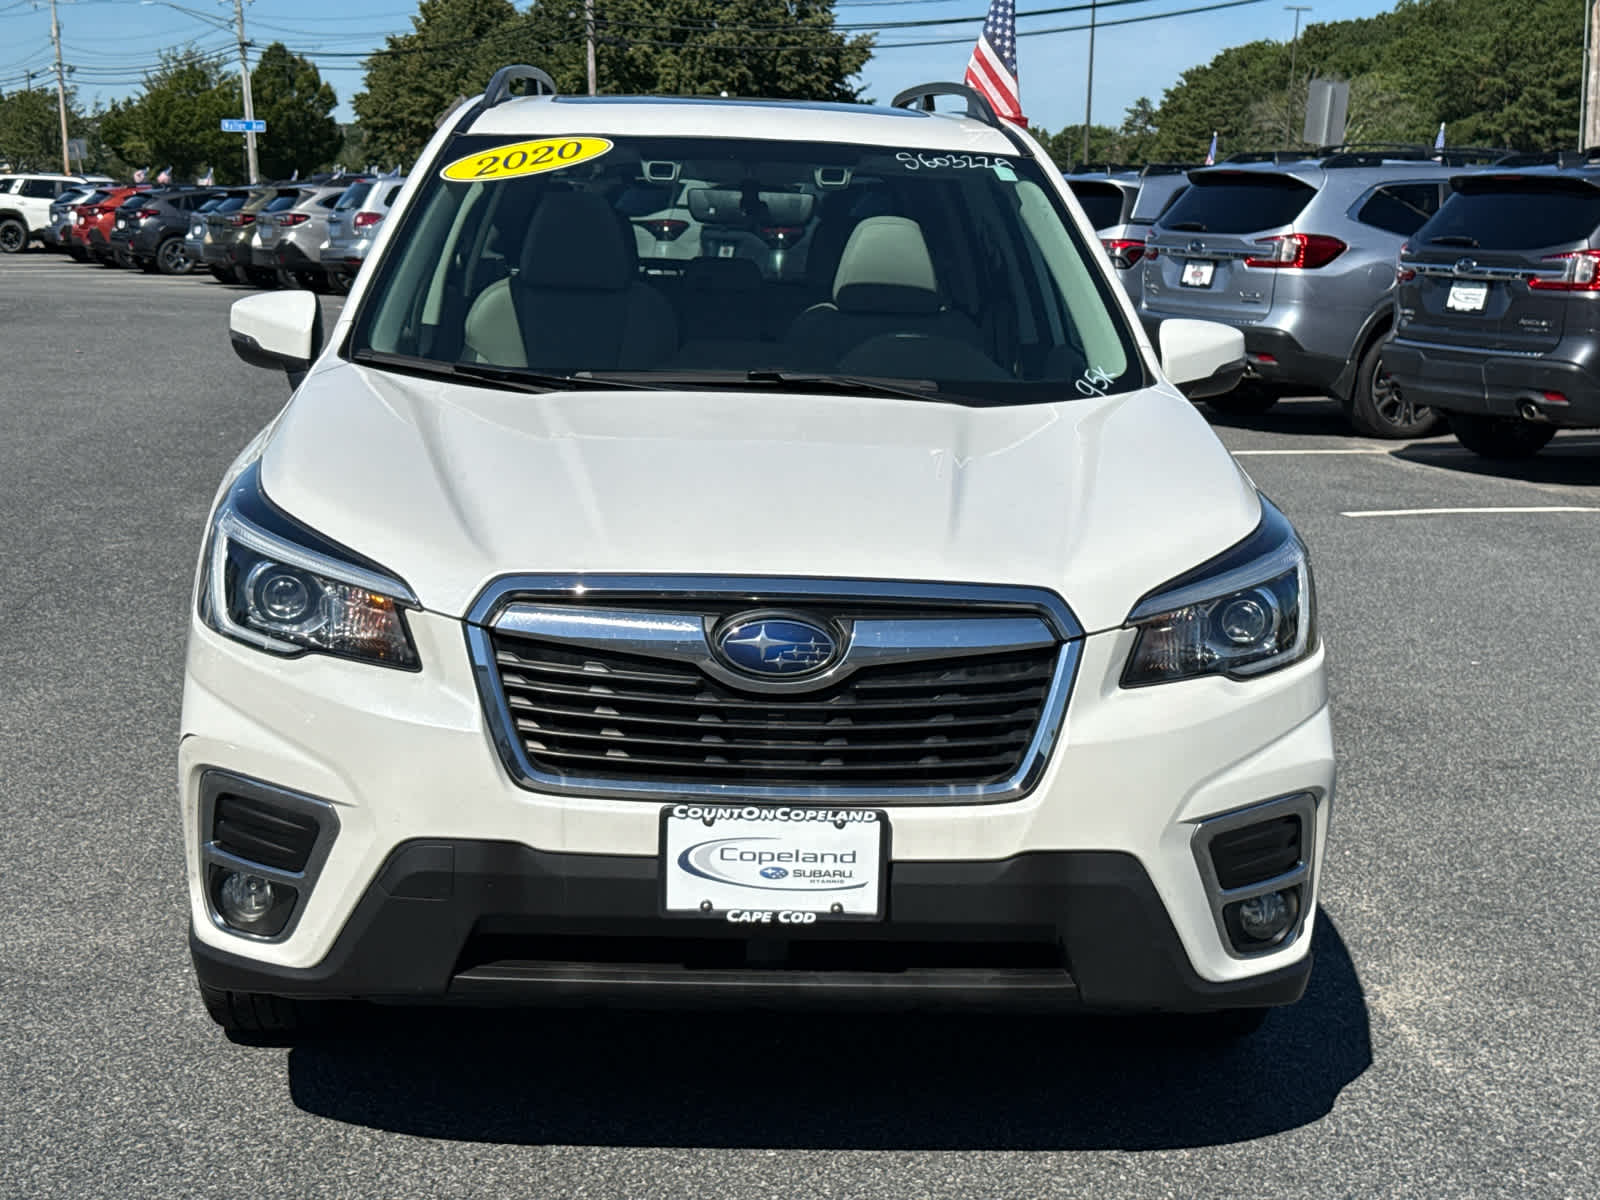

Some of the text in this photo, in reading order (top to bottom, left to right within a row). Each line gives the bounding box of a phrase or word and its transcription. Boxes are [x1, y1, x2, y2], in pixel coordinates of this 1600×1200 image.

[474, 141, 583, 177] 2020
[719, 847, 857, 865] Copeland
[792, 869, 853, 879] SUBARU
[726, 909, 817, 924] CAPE COD
